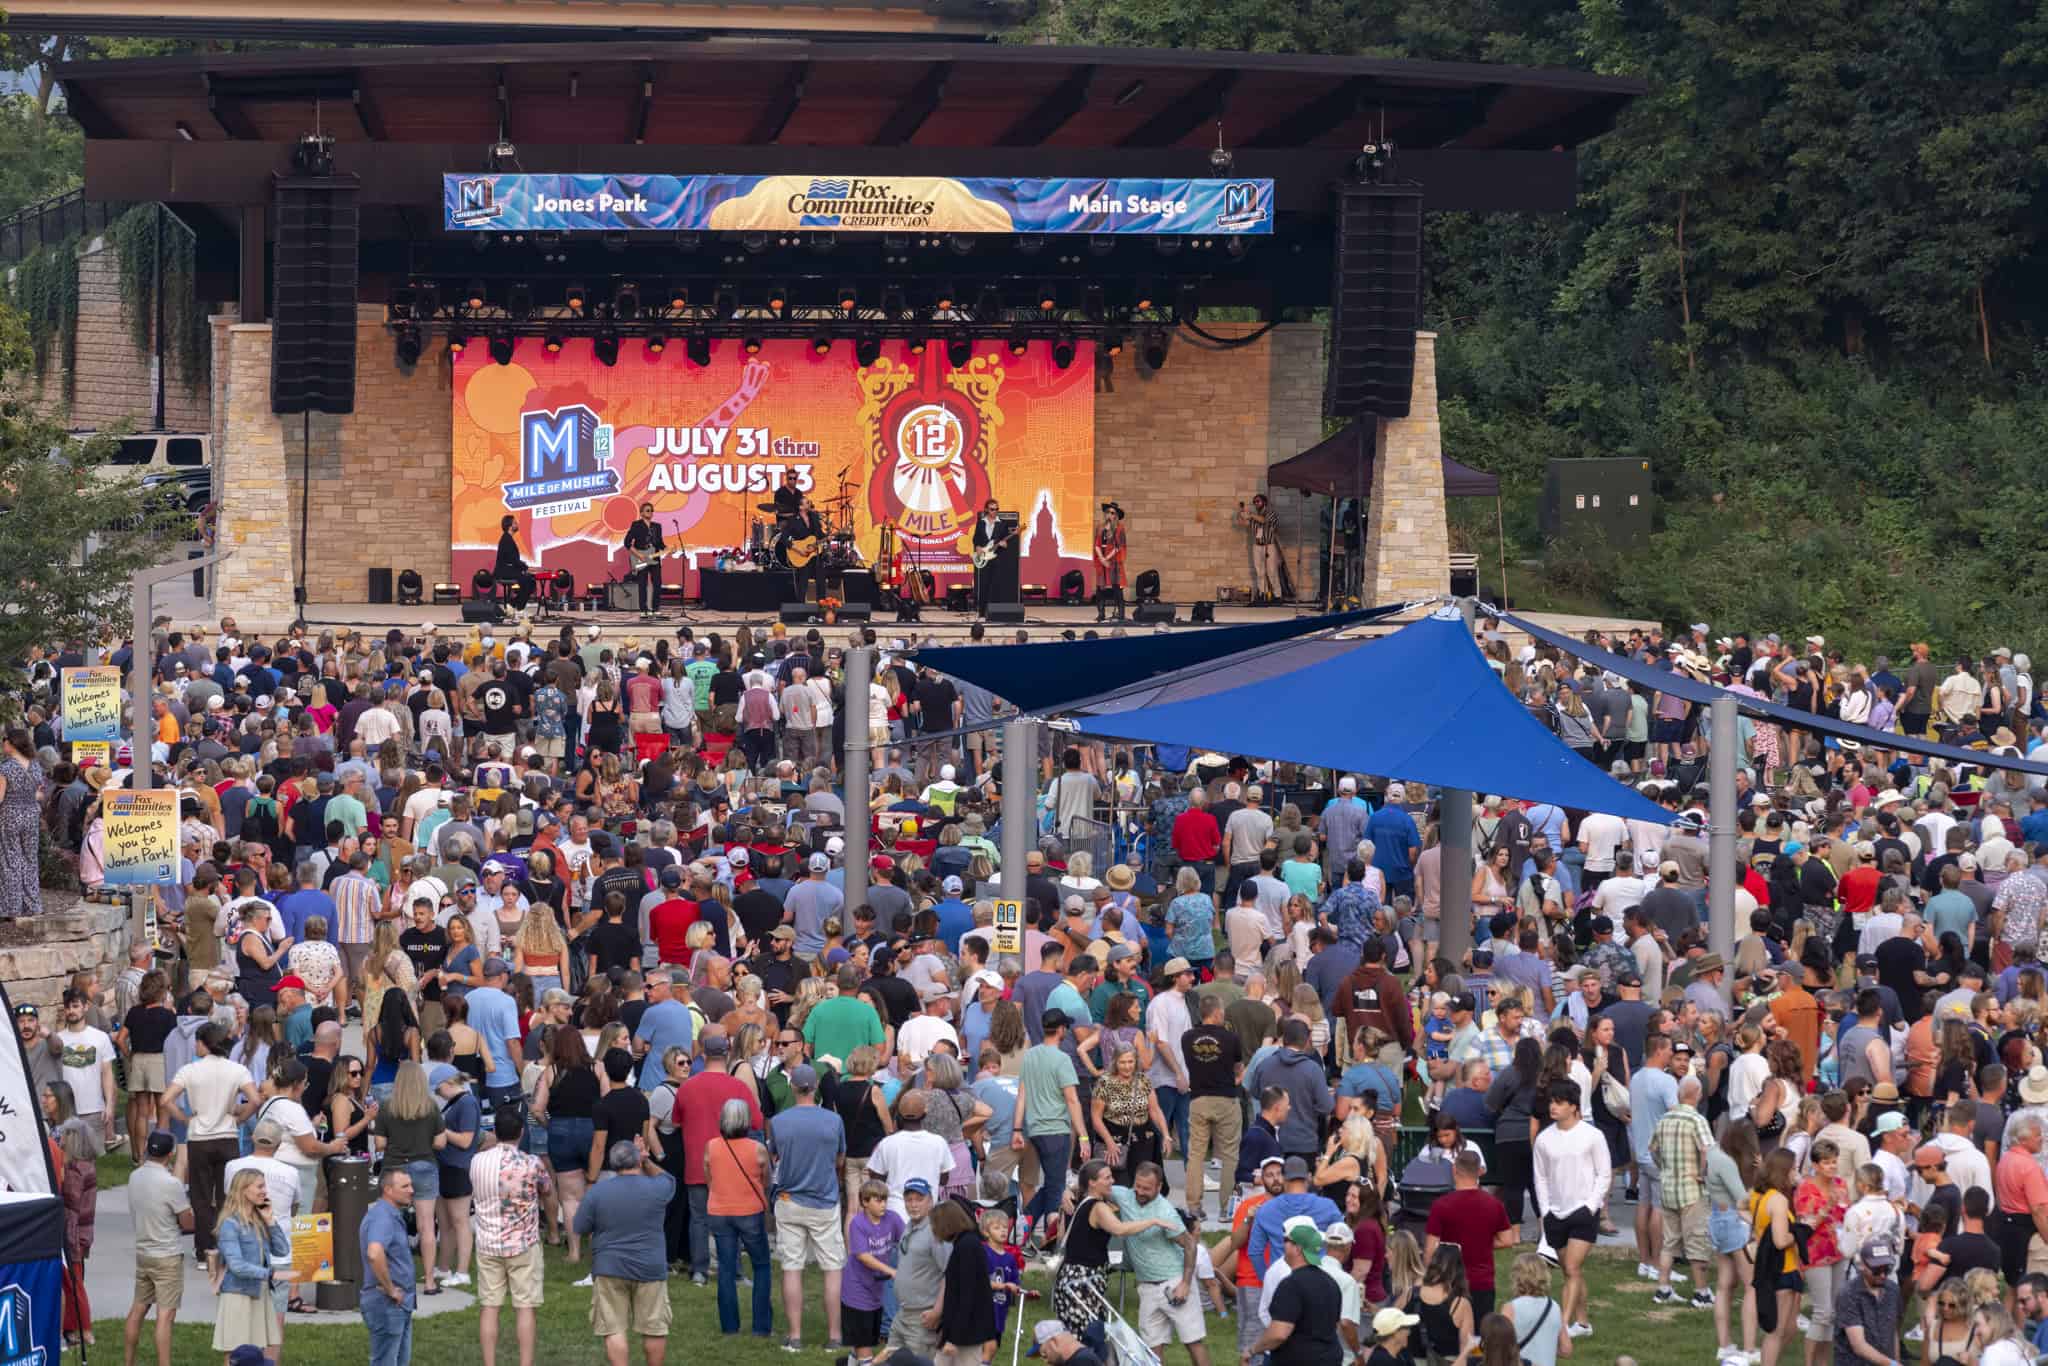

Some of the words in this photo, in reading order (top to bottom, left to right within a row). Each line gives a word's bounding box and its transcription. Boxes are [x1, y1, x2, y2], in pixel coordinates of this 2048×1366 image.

[848, 180, 891, 199] Fox
[532, 193, 595, 212] Jones
[599, 193, 648, 212] Park
[788, 194, 935, 215] Communities
[1068, 194, 1122, 213] Main
[1127, 195, 1187, 218] Stage
[842, 216, 887, 226] CREDIT
[890, 216, 930, 227] UNION
[529, 415, 578, 479] M
[597, 438, 609, 451] 12
[648, 427, 730, 456] JULY
[736, 427, 770, 456] 31
[774, 436, 820, 457] thru
[913, 424, 946, 456] 12
[512, 485, 545, 499] MILE
[547, 485, 560, 494] OF
[561, 474, 605, 490] MUSIC
[648, 464, 787, 493] AUGUST
[795, 464, 815, 493] 3
[535, 501, 588, 517] FESTIVAL
[905, 512, 953, 532] MILE
[67, 689, 110, 705] Welcomes
[67, 717, 93, 730] Jones
[95, 704, 118, 723] Park!
[76, 706, 92, 719] you
[96, 701, 106, 711] to
[107, 801, 172, 811] Communities
[134, 795, 152, 804] Fox
[107, 820, 162, 838] Welcomes
[107, 852, 139, 869] Jones
[141, 839, 173, 863] Park!
[118, 839, 138, 857] you
[143, 833, 156, 846] to
